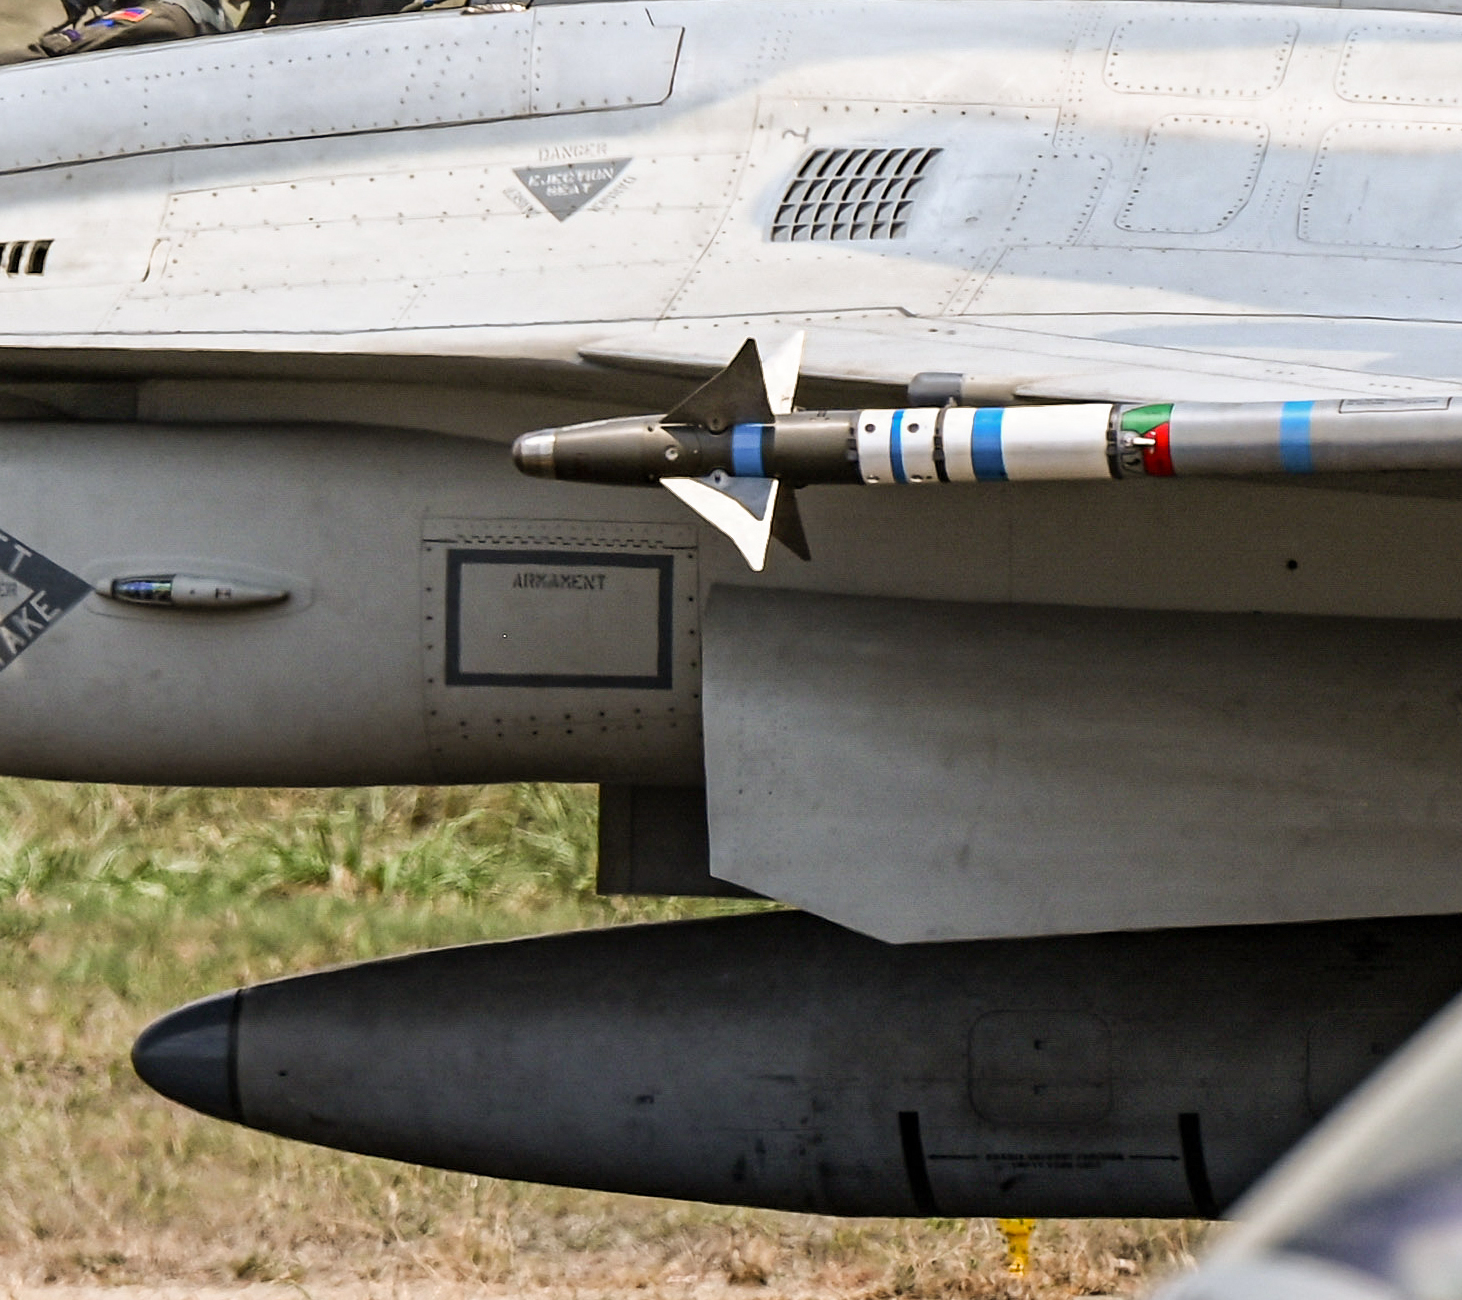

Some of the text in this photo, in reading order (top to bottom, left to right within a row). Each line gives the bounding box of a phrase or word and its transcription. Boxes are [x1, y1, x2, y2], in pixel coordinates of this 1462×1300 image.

[538, 142, 608, 161] DANGER
[528, 168, 614, 187] EJECTION
[546, 183, 592, 197] SEAT
[512, 572, 606, 590] ARMAMENT
